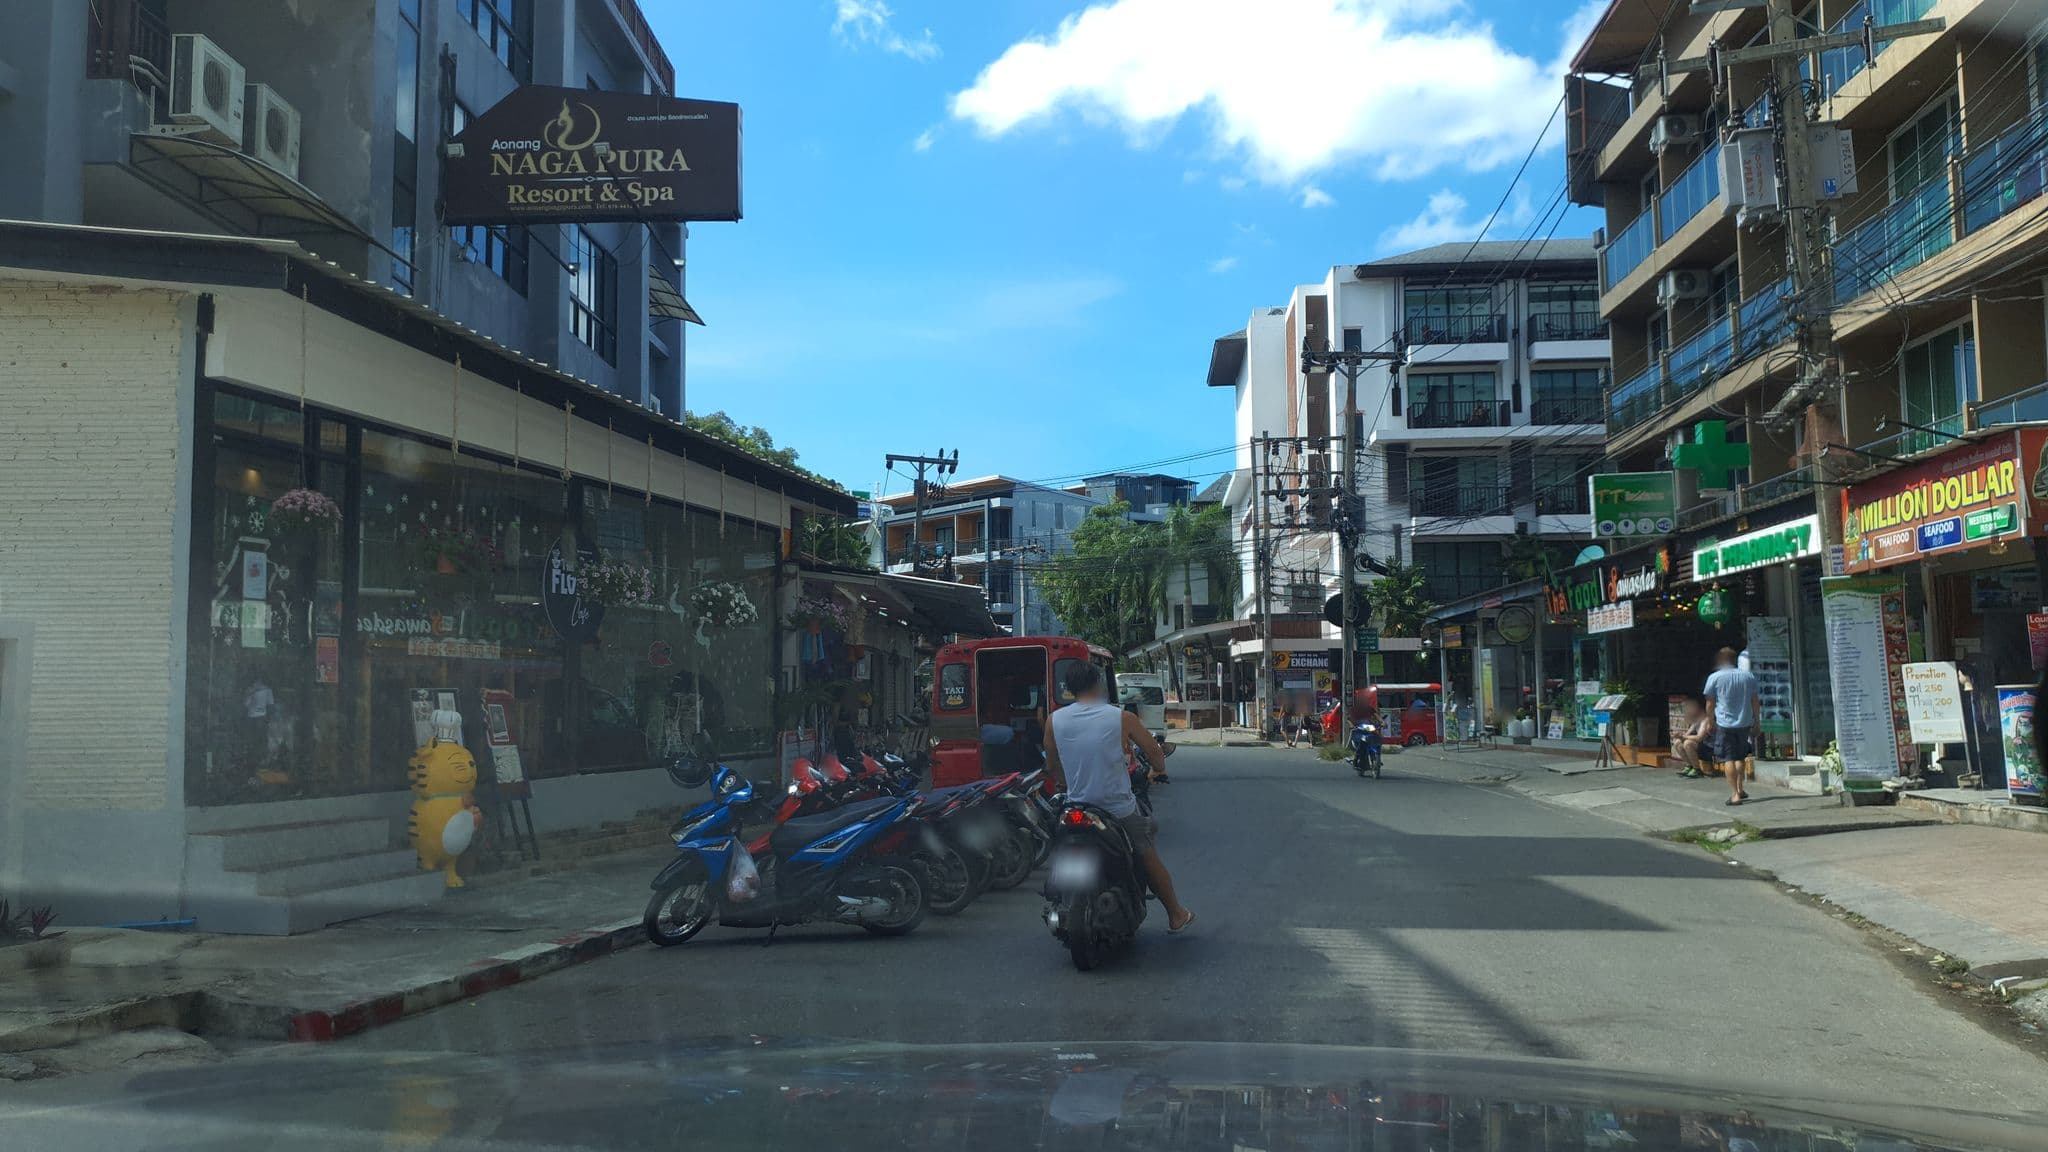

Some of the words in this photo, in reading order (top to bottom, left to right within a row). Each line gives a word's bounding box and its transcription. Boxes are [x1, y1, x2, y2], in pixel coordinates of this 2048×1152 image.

[491, 138, 541, 151] Aonang
[490, 151, 588, 176] NAGA
[595, 148, 691, 174] PURA
[507, 184, 594, 205] Resort
[600, 182, 620, 203] &
[627, 182, 674, 206] Spa
[1860, 484, 1929, 533] MILLION
[1932, 459, 2015, 514] DOLLAR
[1924, 520, 1954, 537] SEAFOOD
[1720, 523, 1812, 571] PHARMACY
[1878, 535, 1893, 549] THAI
[1893, 532, 1910, 545] FOOD
[1291, 657, 1329, 667] EXCHANG
[944, 687, 965, 695] TAXI
